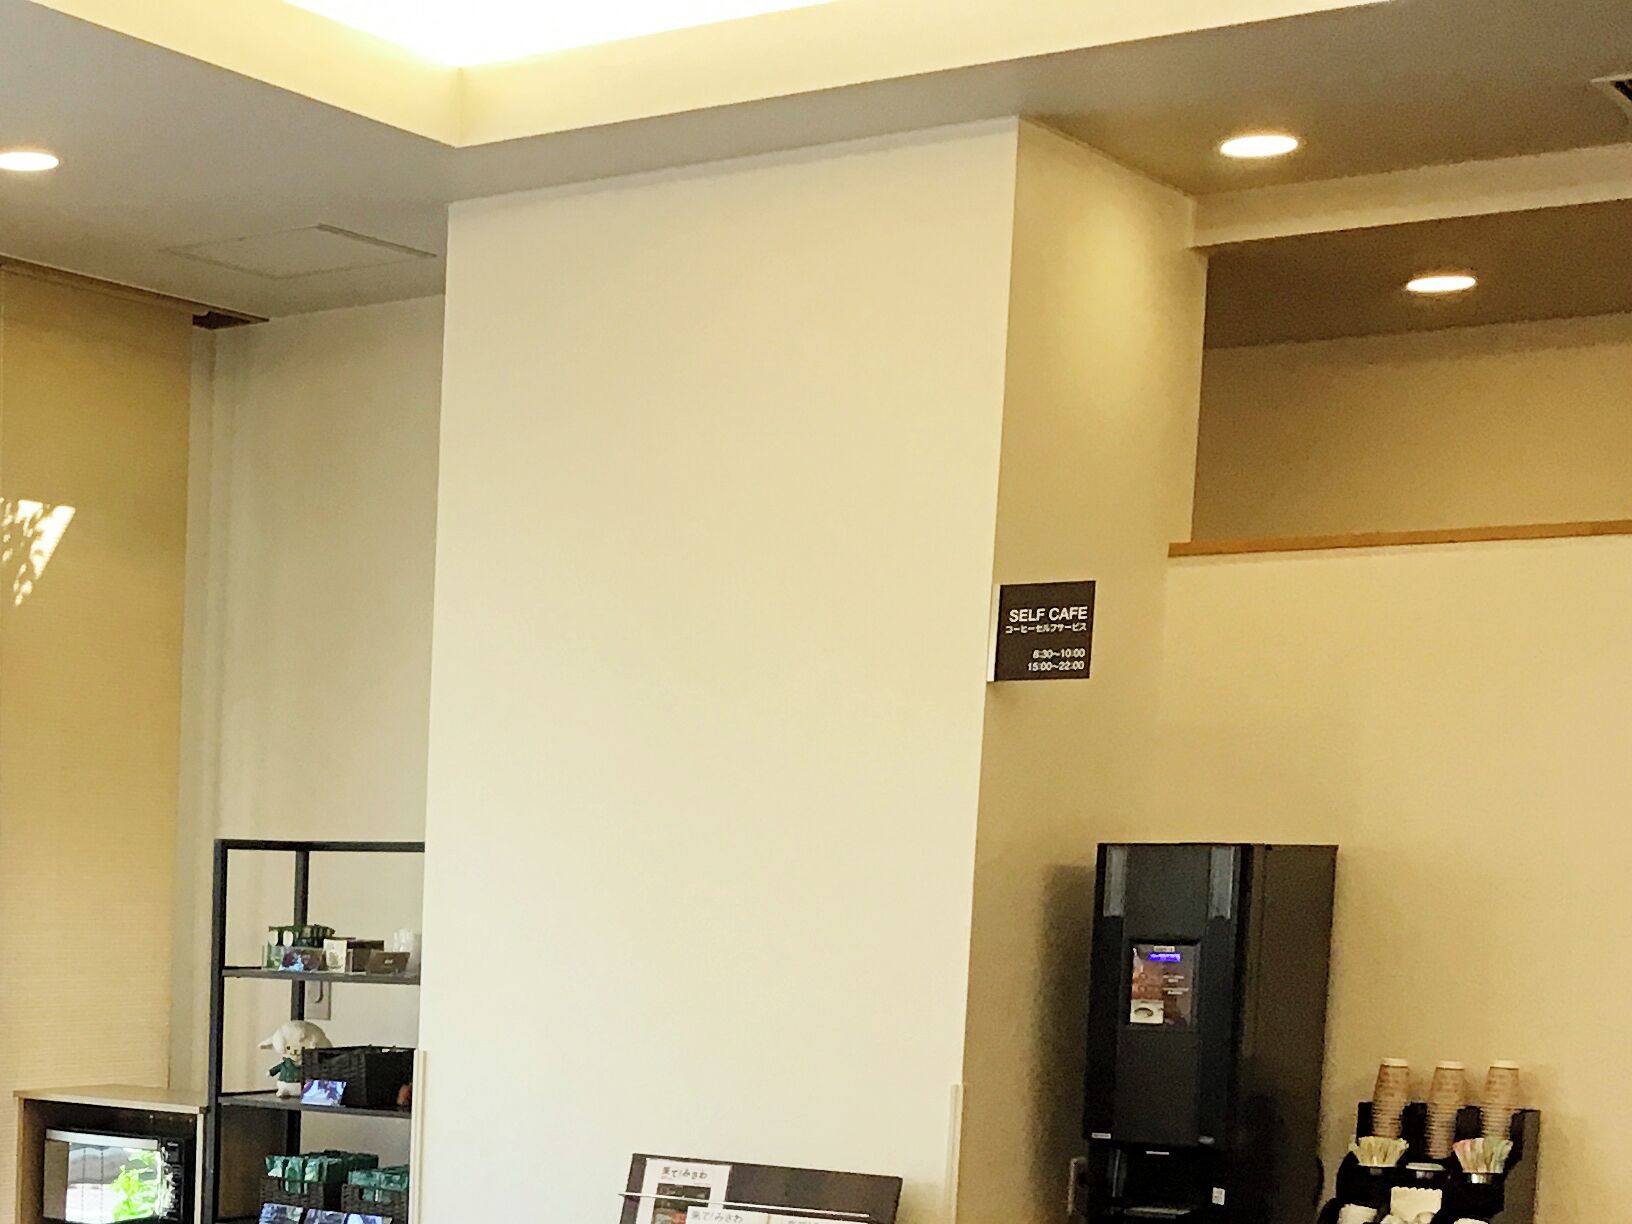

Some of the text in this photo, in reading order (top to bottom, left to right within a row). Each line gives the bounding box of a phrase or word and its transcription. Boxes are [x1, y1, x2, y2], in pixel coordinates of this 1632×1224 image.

[1009, 606, 1088, 623] SELF CAFE
[1005, 622, 1087, 634] コーヒーセルフサービス
